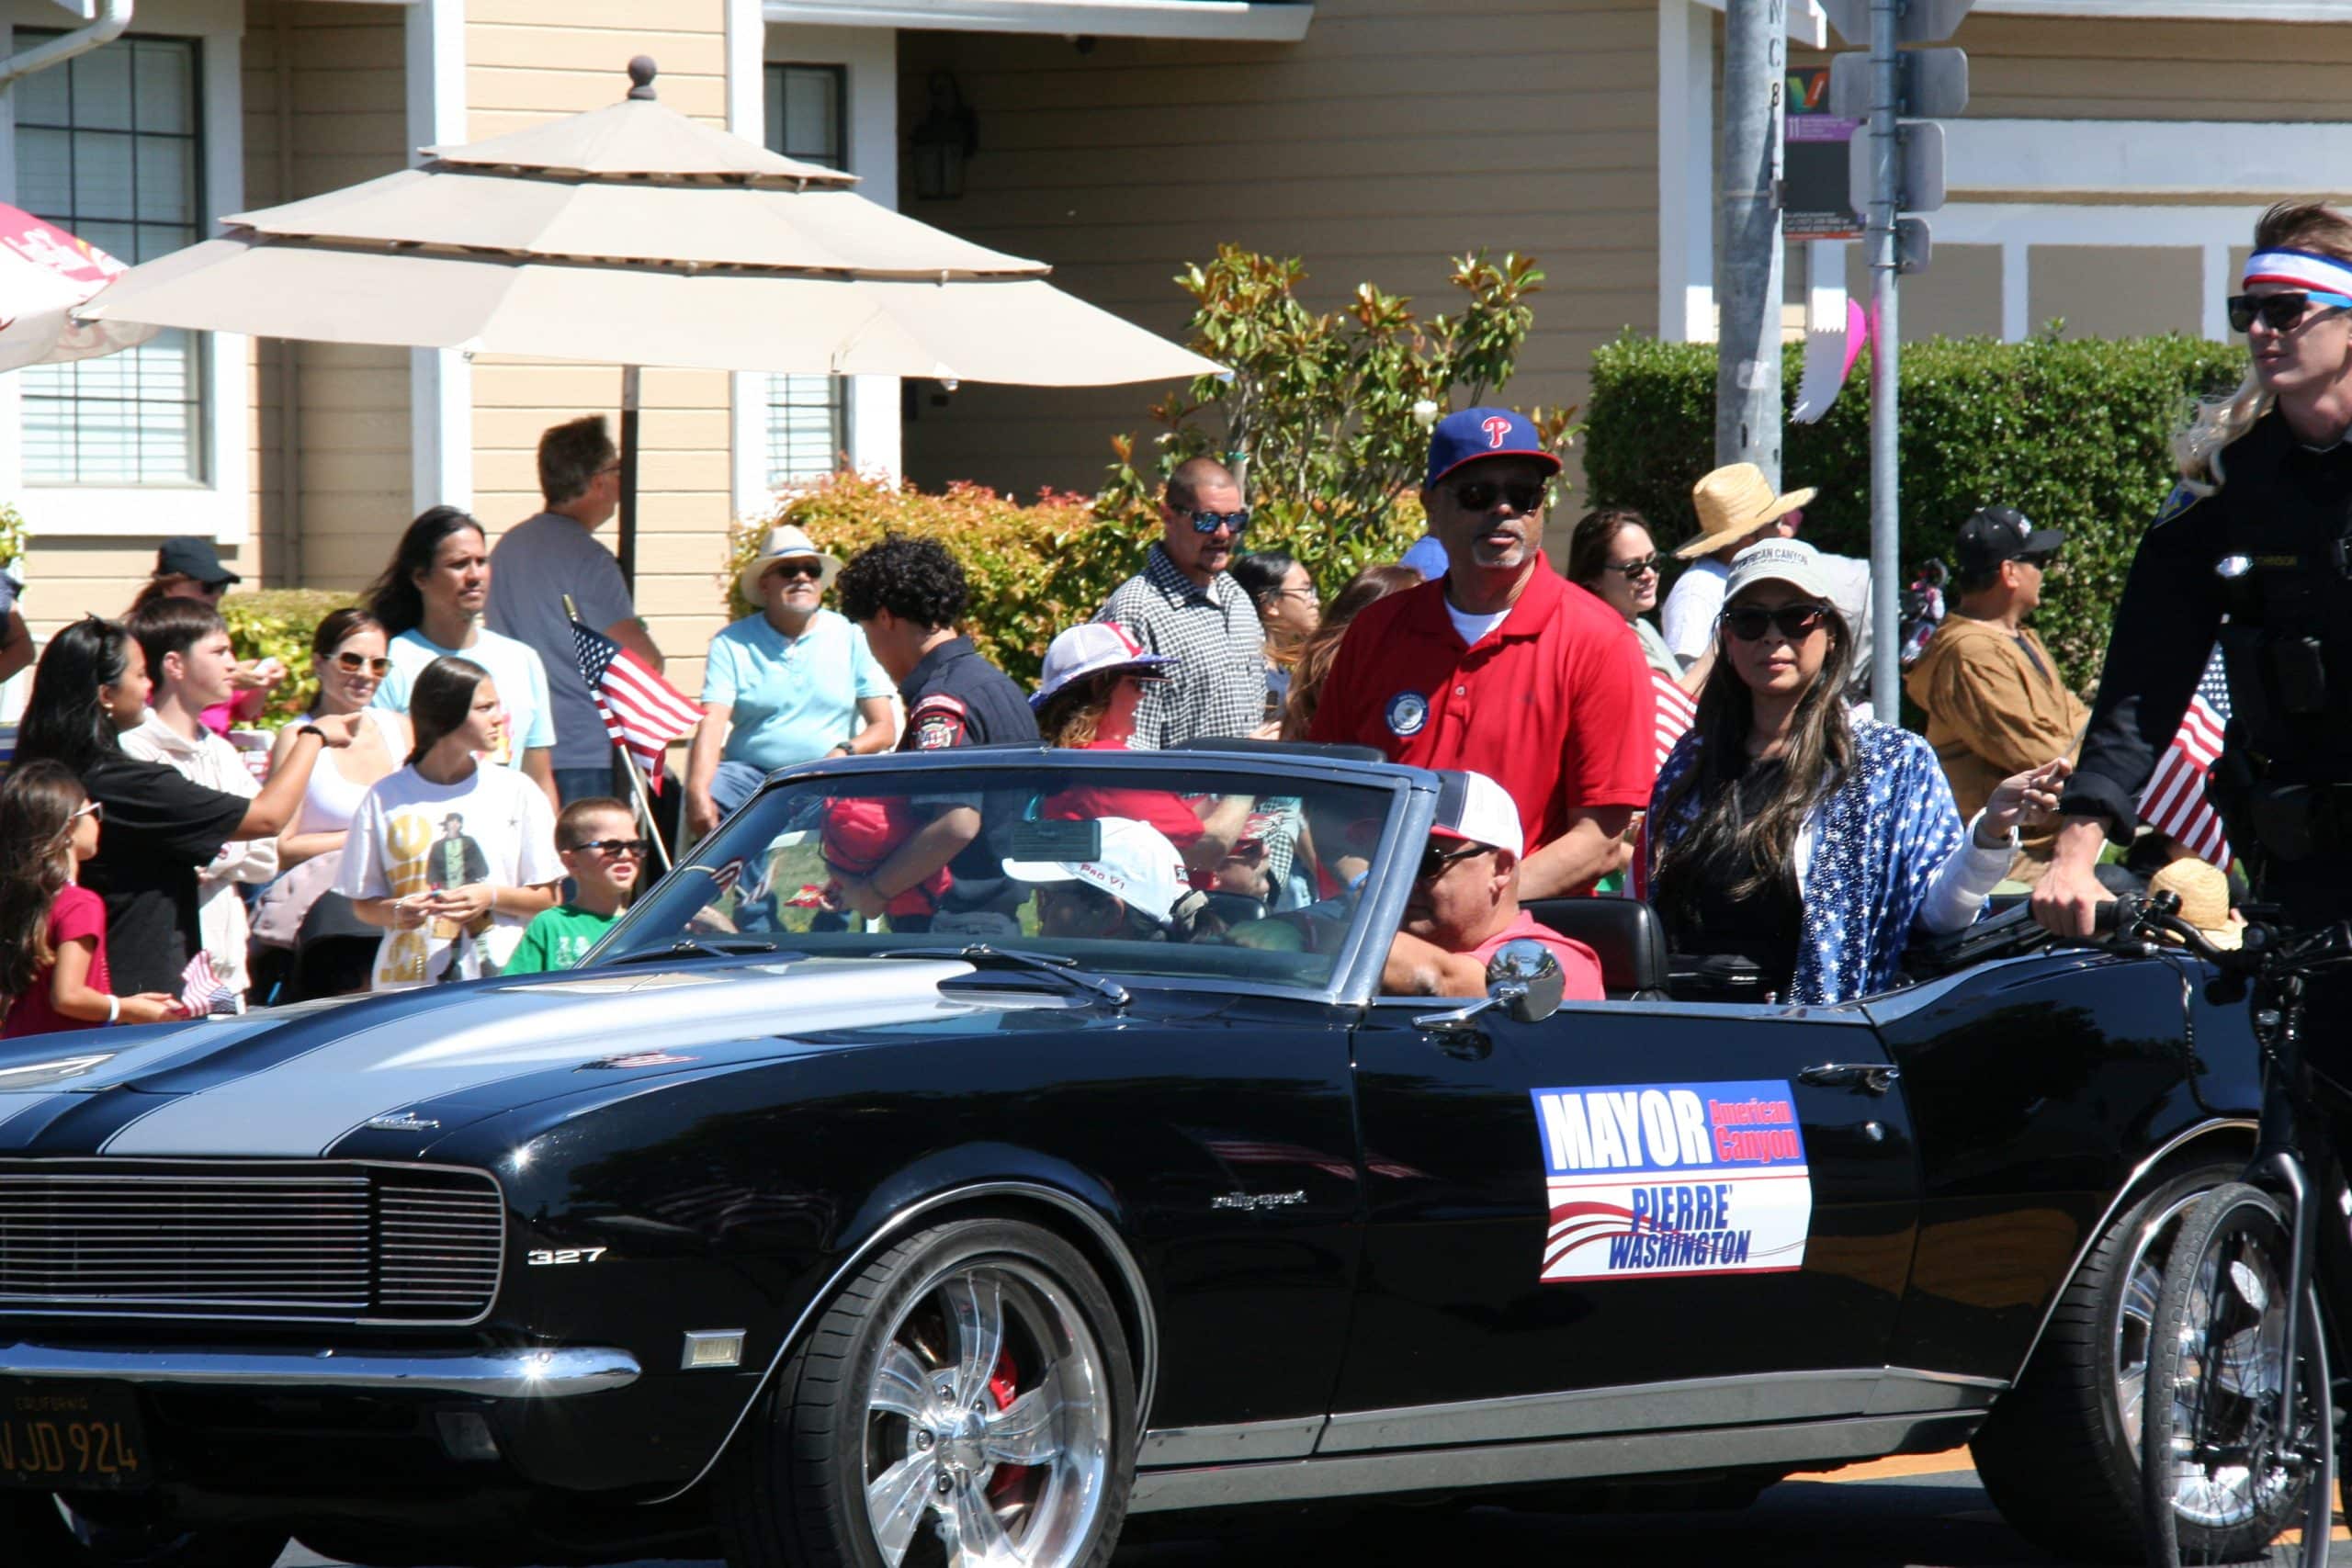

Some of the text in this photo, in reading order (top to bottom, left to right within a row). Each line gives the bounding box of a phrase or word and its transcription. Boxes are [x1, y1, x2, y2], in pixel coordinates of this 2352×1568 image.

[1481, 416, 1512, 448] P
[1539, 1089, 1793, 1170] MAYOR American
[1713, 1124, 1801, 1164] Canyon
[527, 1247, 607, 1265] 327
[1608, 1230, 1751, 1269] WASHINGTON
